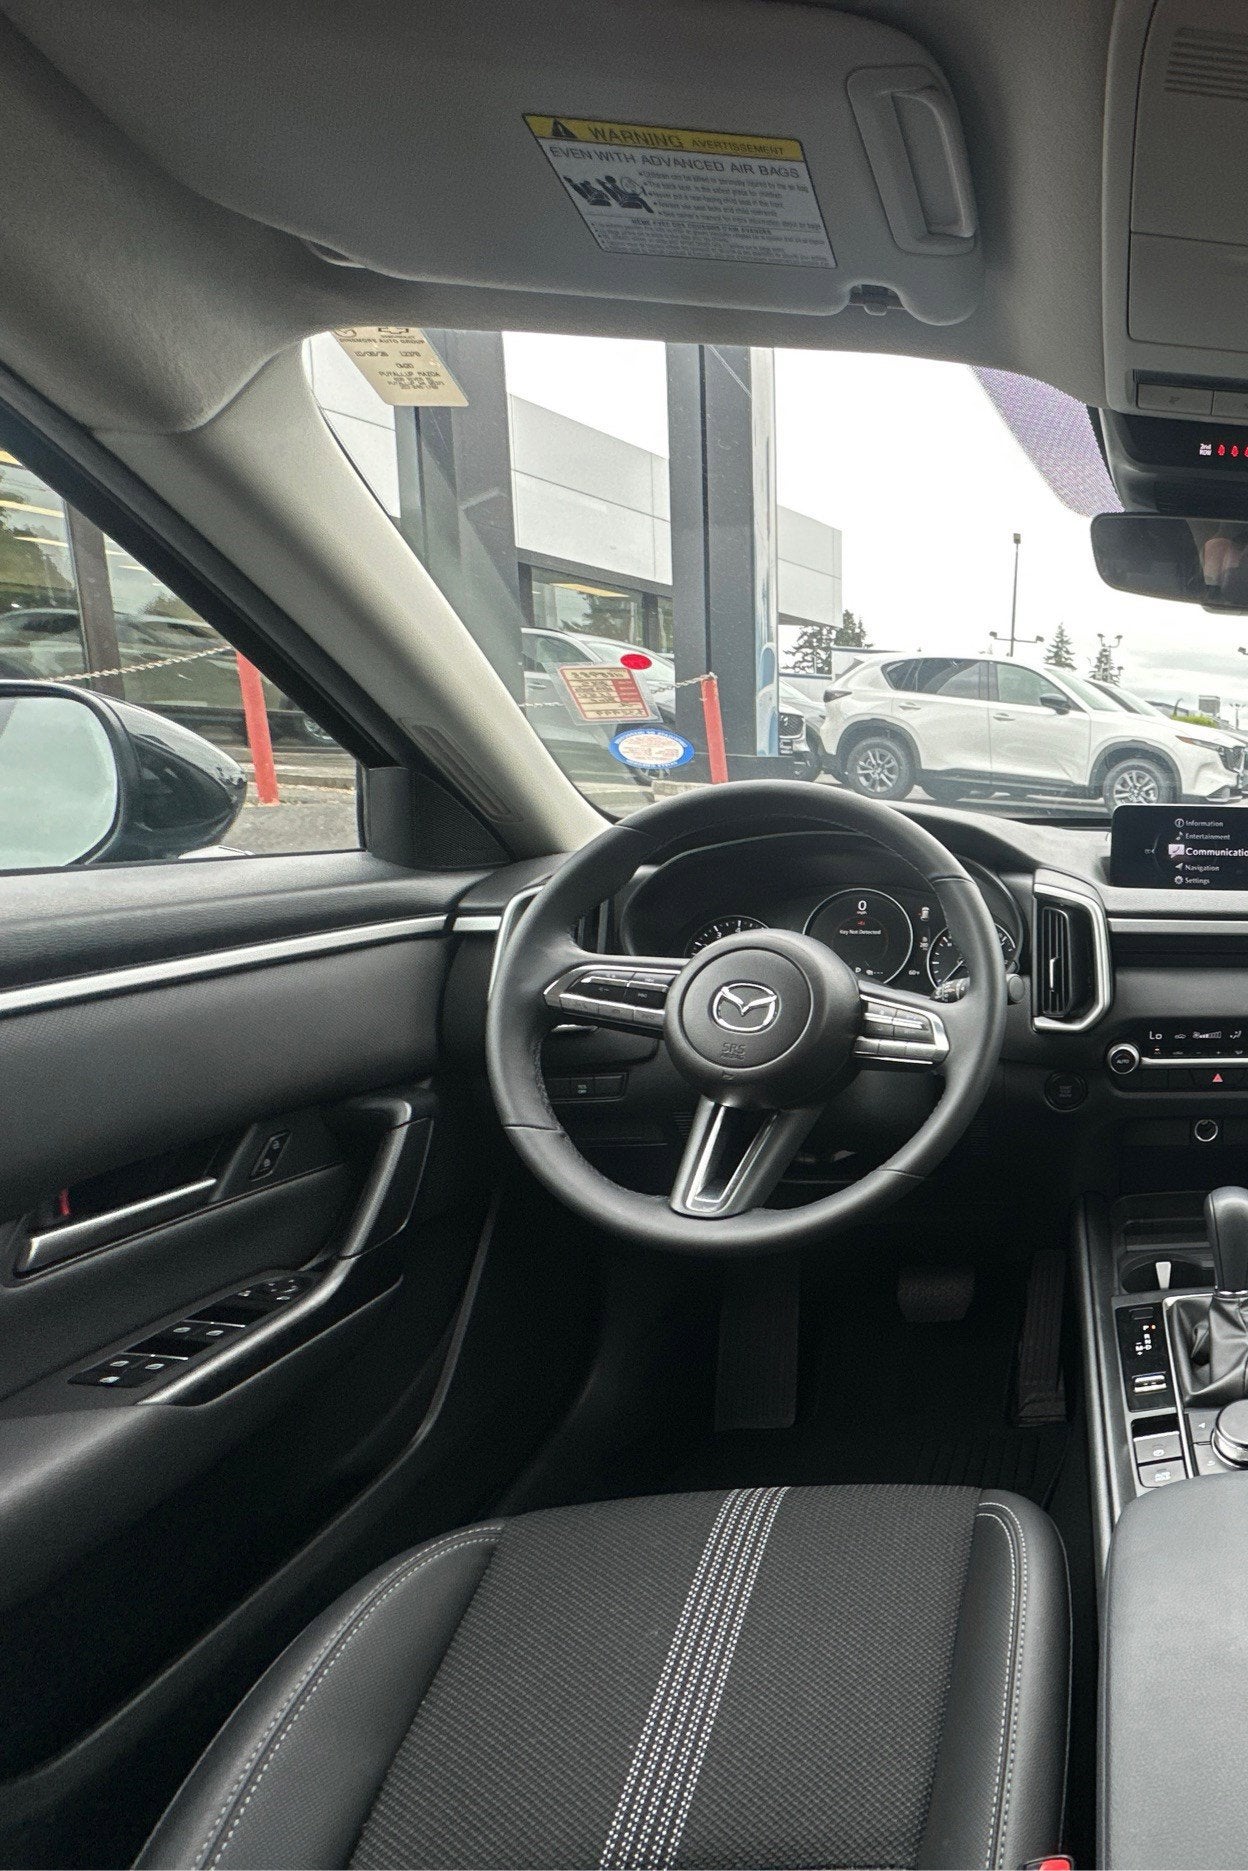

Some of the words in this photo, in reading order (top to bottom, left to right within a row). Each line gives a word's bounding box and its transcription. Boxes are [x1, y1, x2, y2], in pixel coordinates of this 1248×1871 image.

[588, 127, 684, 149] WARNING
[691, 138, 784, 156] AVERTISSEMENT
[550, 146, 593, 161] EVEN
[597, 150, 637, 165] WITH
[641, 153, 725, 173] ADVANCED
[730, 161, 754, 175] AIR
[759, 164, 800, 179] BAGS
[1185, 820, 1224, 828] Information
[1185, 832, 1231, 840] Entertainment
[1185, 864, 1220, 872] Navigation
[1185, 877, 1210, 885] Settings
[858, 900, 867, 911] 0
[721, 1041, 746, 1055] SRS
